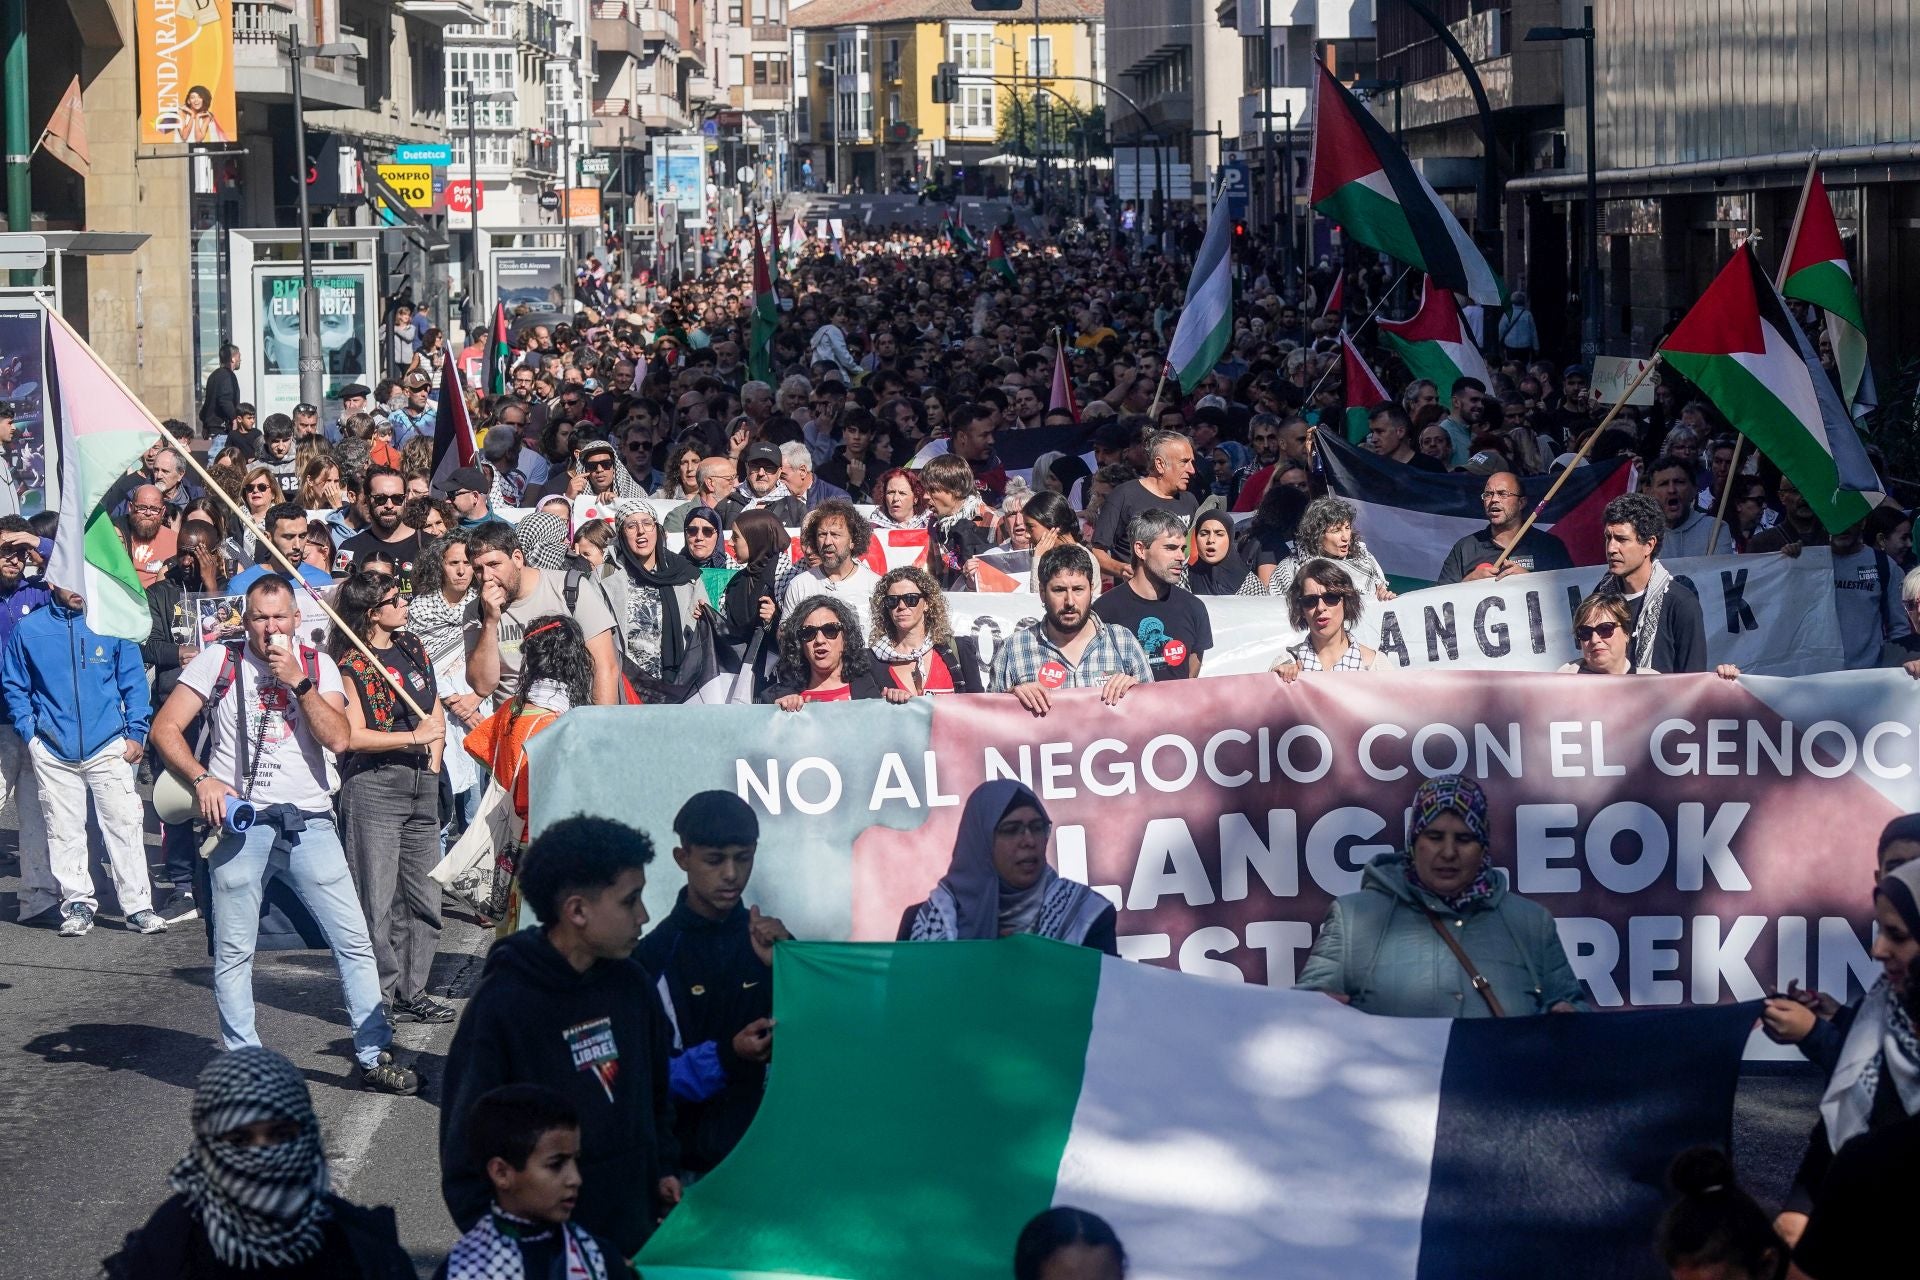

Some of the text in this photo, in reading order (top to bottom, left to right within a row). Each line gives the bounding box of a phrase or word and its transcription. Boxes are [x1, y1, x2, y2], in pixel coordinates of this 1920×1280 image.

[381, 172, 430, 181] COMPRO
[394, 187, 425, 200] RO
[1164, 646, 1184, 657] LAB
[1041, 667, 1064, 679] LAB
[735, 717, 1920, 815] NO AL NEGOCIO CON EL GENOC
